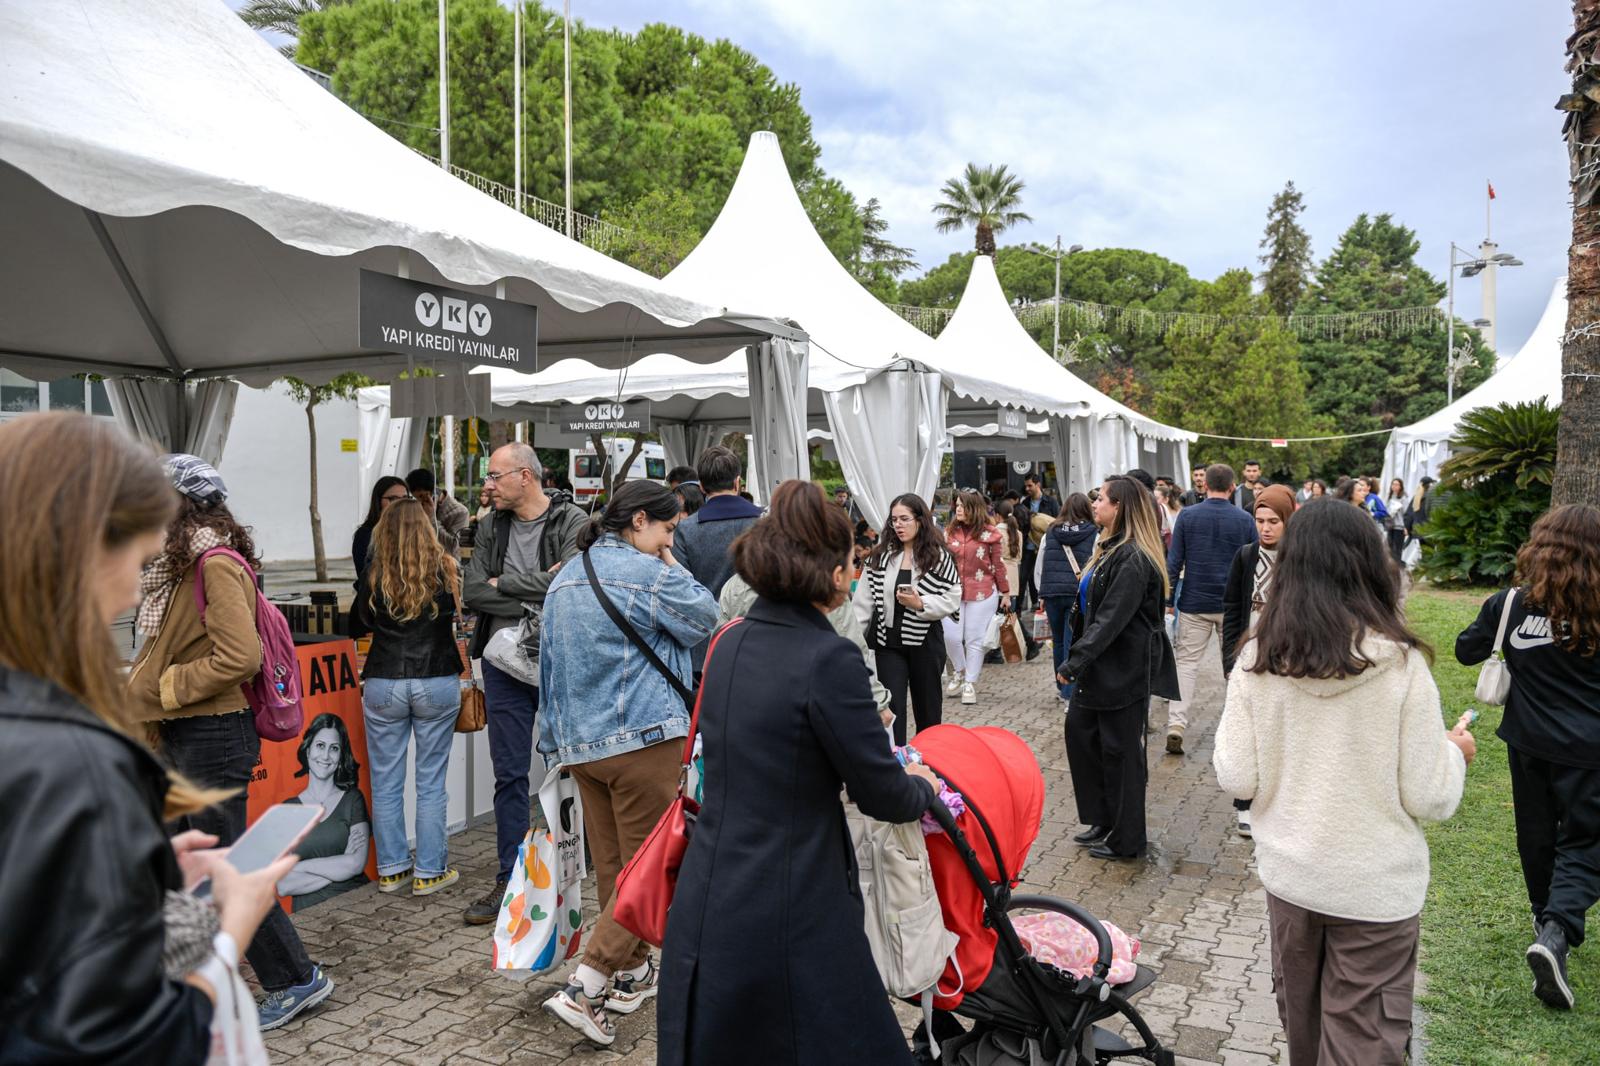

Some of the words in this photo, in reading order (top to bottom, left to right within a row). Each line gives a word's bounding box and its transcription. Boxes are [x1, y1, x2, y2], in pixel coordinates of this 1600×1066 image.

[418, 296, 489, 332] YKY
[381, 326, 412, 346] YAPI
[415, 332, 455, 353] KREDİ
[458, 338, 520, 362] YAYINLARI
[569, 422, 584, 430] YAPI
[585, 421, 605, 430] KREDİ
[1518, 614, 1569, 637] NIK
